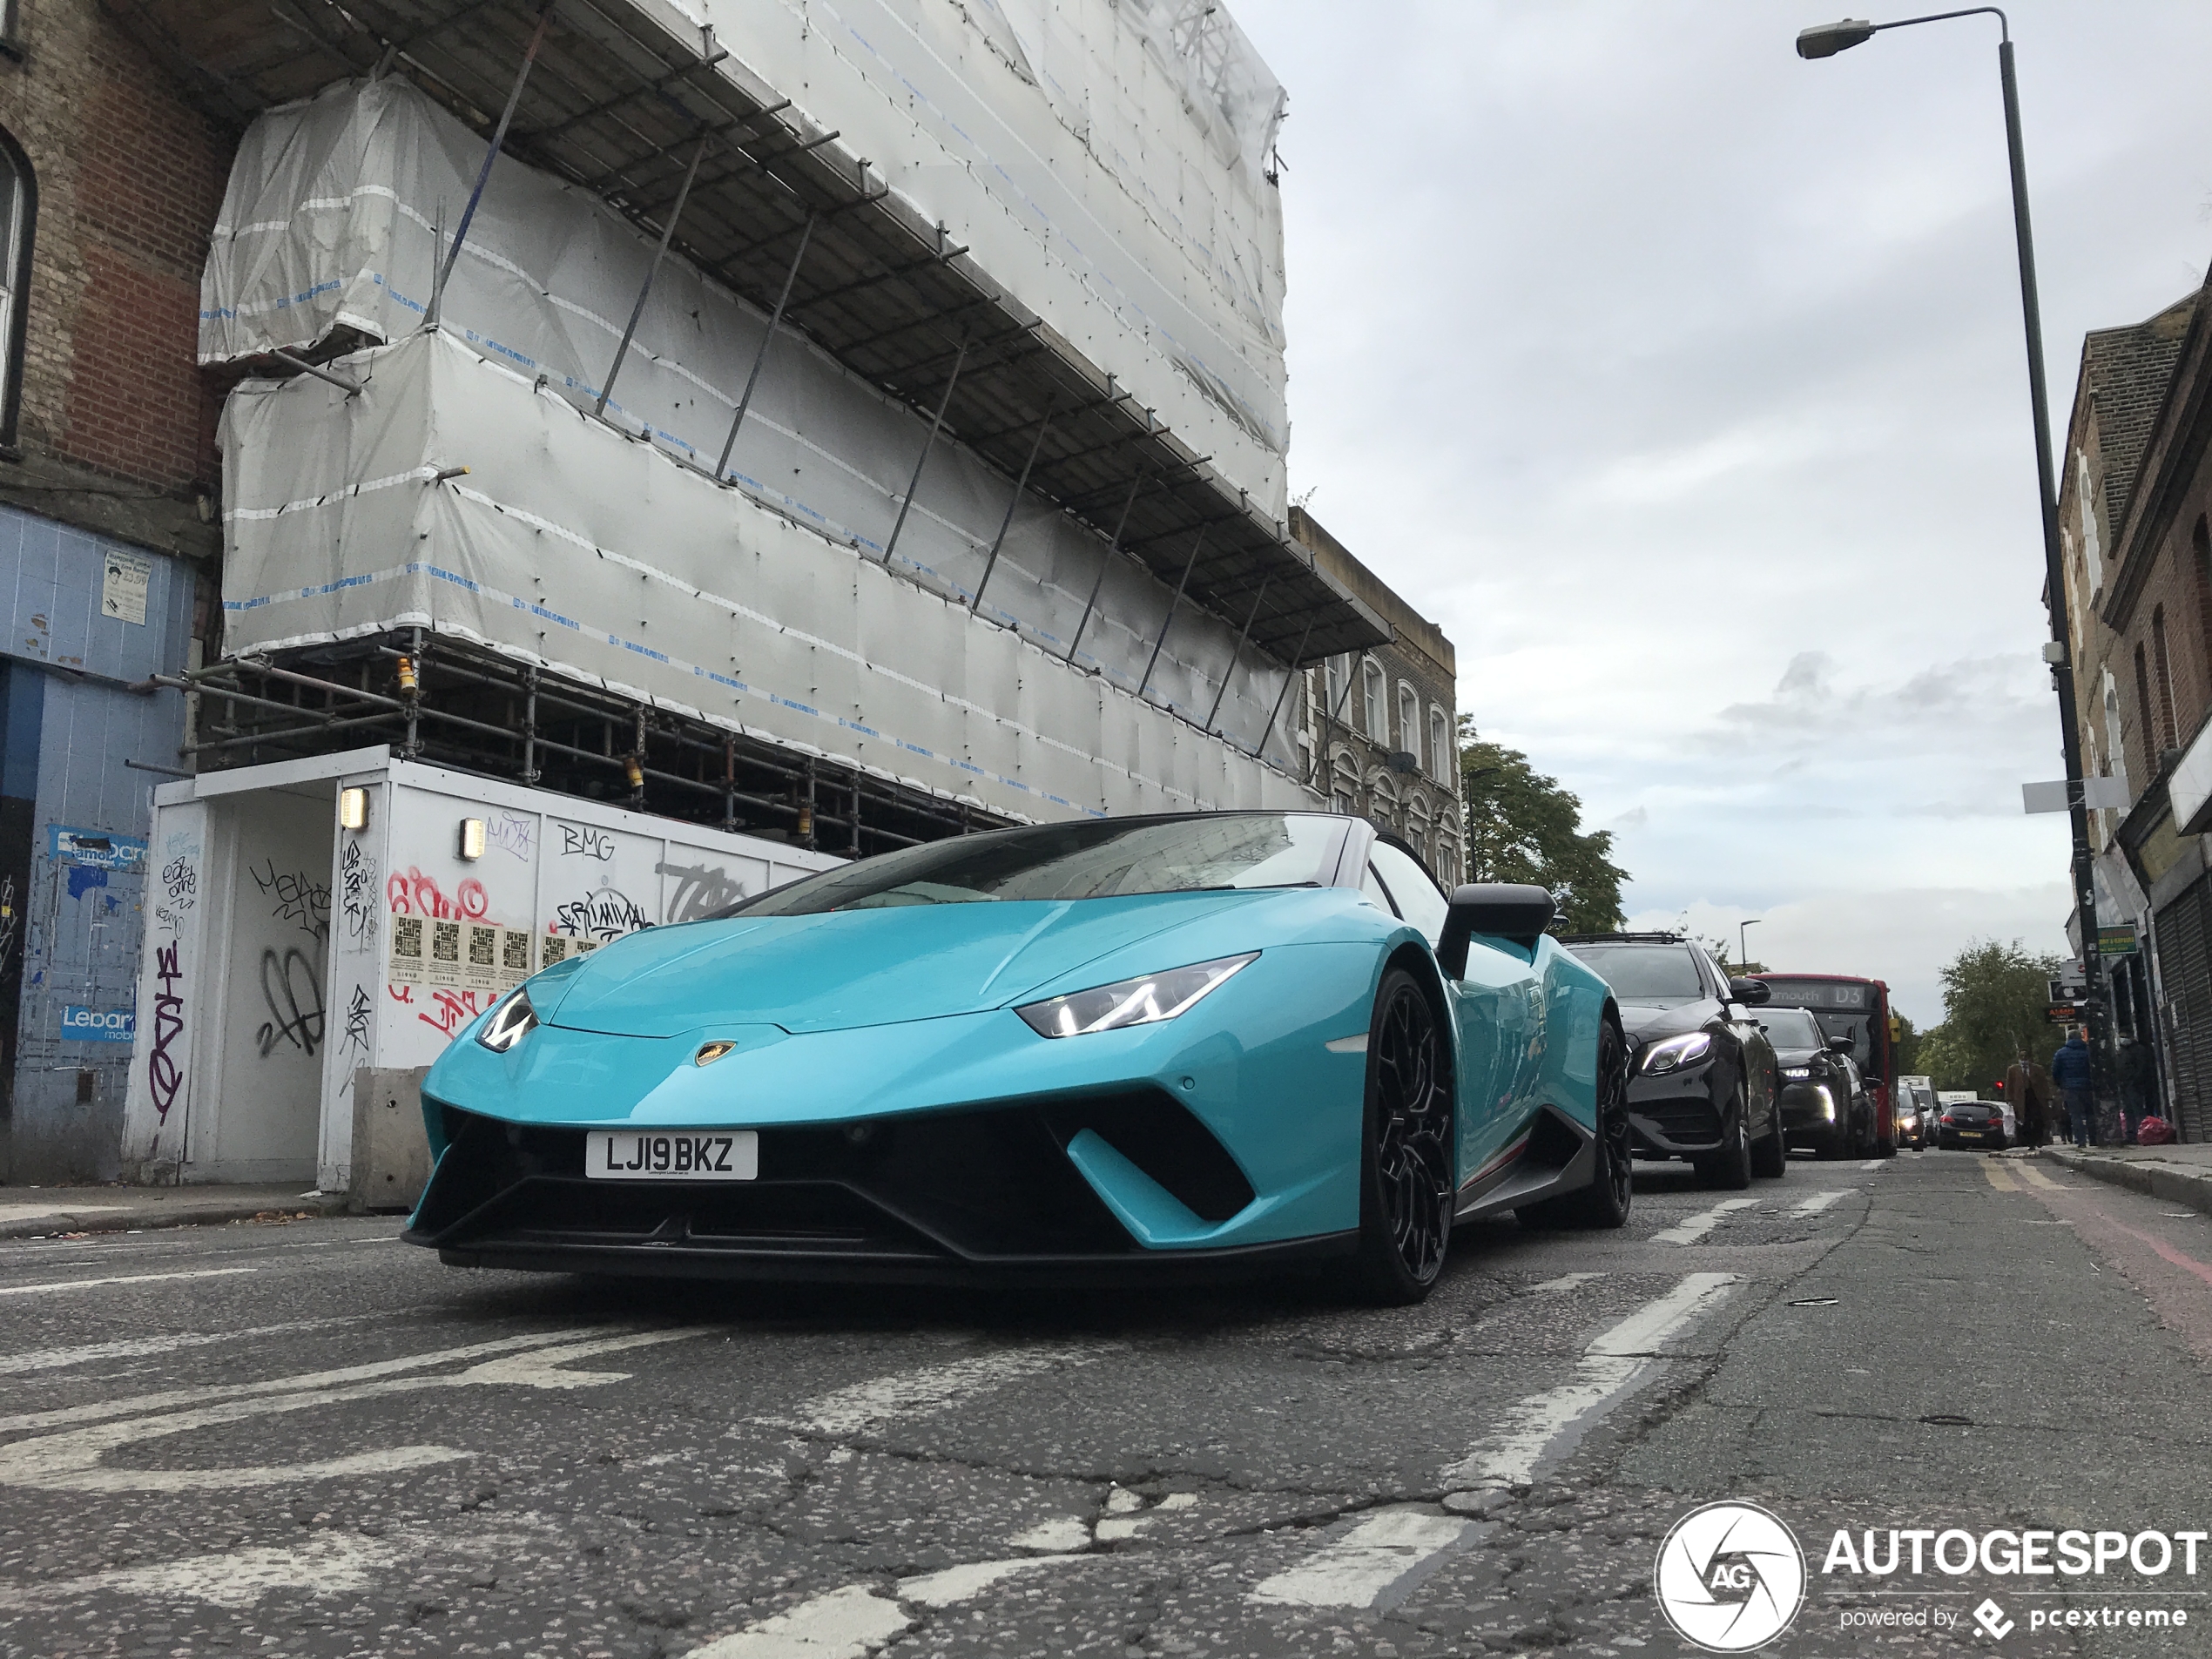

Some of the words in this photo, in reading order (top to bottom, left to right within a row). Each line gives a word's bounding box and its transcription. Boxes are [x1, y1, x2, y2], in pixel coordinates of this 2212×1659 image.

[557, 824, 615, 861] BMG
[1770, 990, 1819, 1001] amouth
[1835, 987, 1860, 1004] D3
